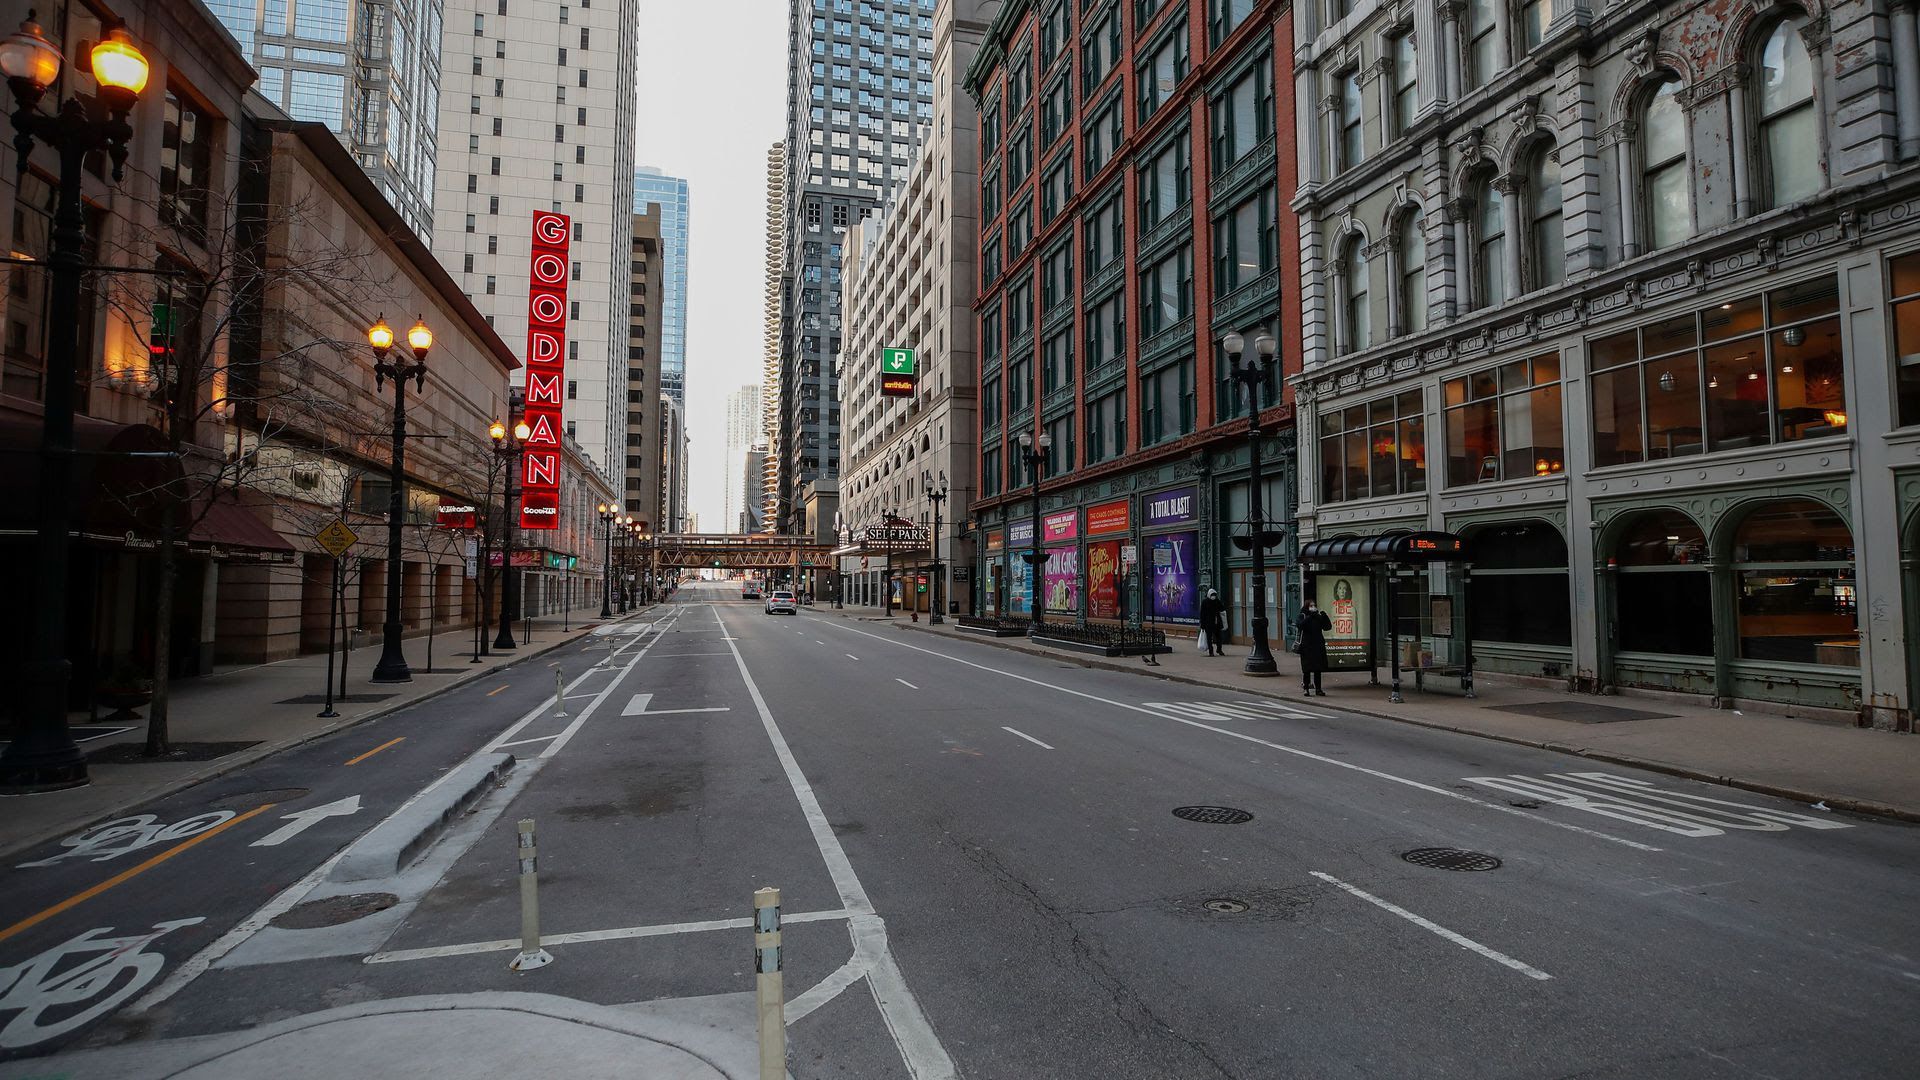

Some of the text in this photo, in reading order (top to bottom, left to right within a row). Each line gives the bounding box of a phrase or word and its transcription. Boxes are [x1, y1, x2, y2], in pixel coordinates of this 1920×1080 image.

[527, 215, 567, 485] GOODMAN
[1155, 499, 1171, 519] TOTAL
[869, 528, 896, 540] SELF
[898, 529, 926, 540] PARK
[1010, 529, 1034, 541] BEST MUSICA
[1045, 551, 1078, 575] MEAN GIRLS
[1333, 619, 1353, 634] 100
